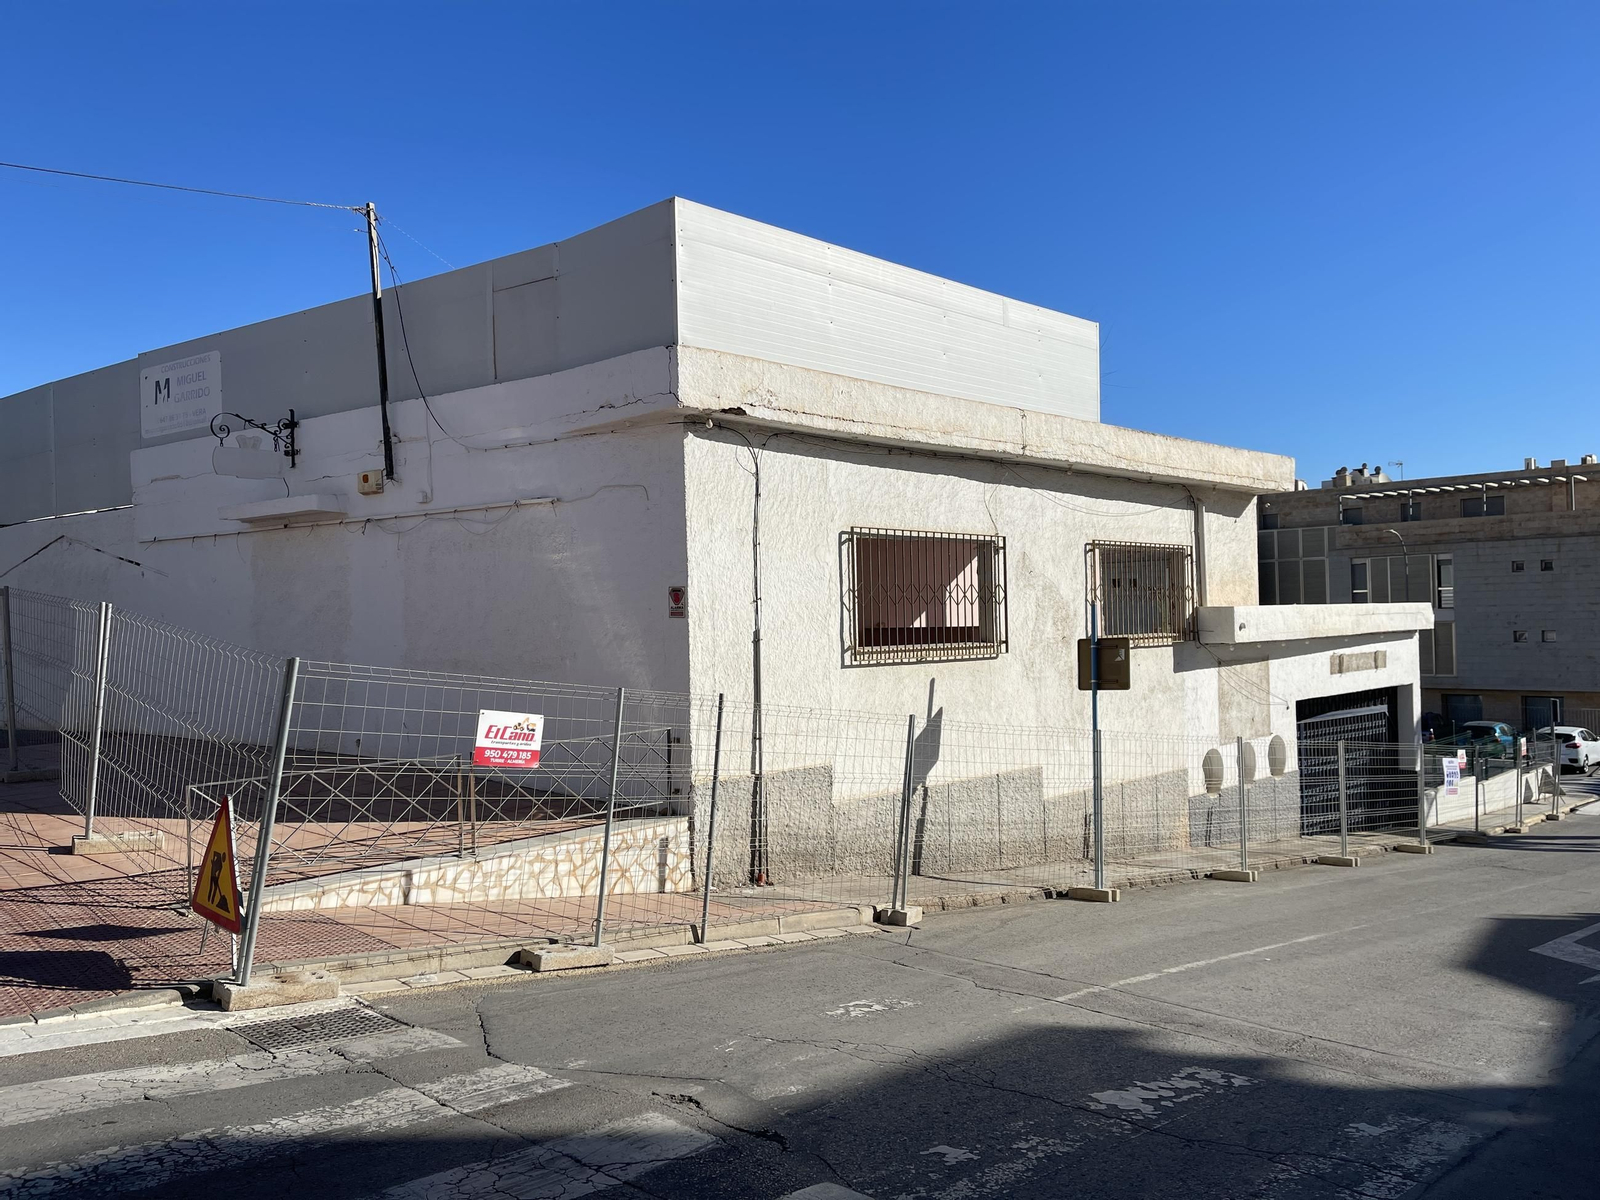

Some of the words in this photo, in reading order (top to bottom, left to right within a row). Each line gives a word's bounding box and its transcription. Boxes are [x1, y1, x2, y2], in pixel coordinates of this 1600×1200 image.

[161, 354, 211, 373] CONSTRUCCIONES
[176, 370, 207, 386] MIGUEL
[174, 386, 210, 403] GARRIDO
[192, 408, 206, 417] VERA
[484, 750, 501, 758] 950
